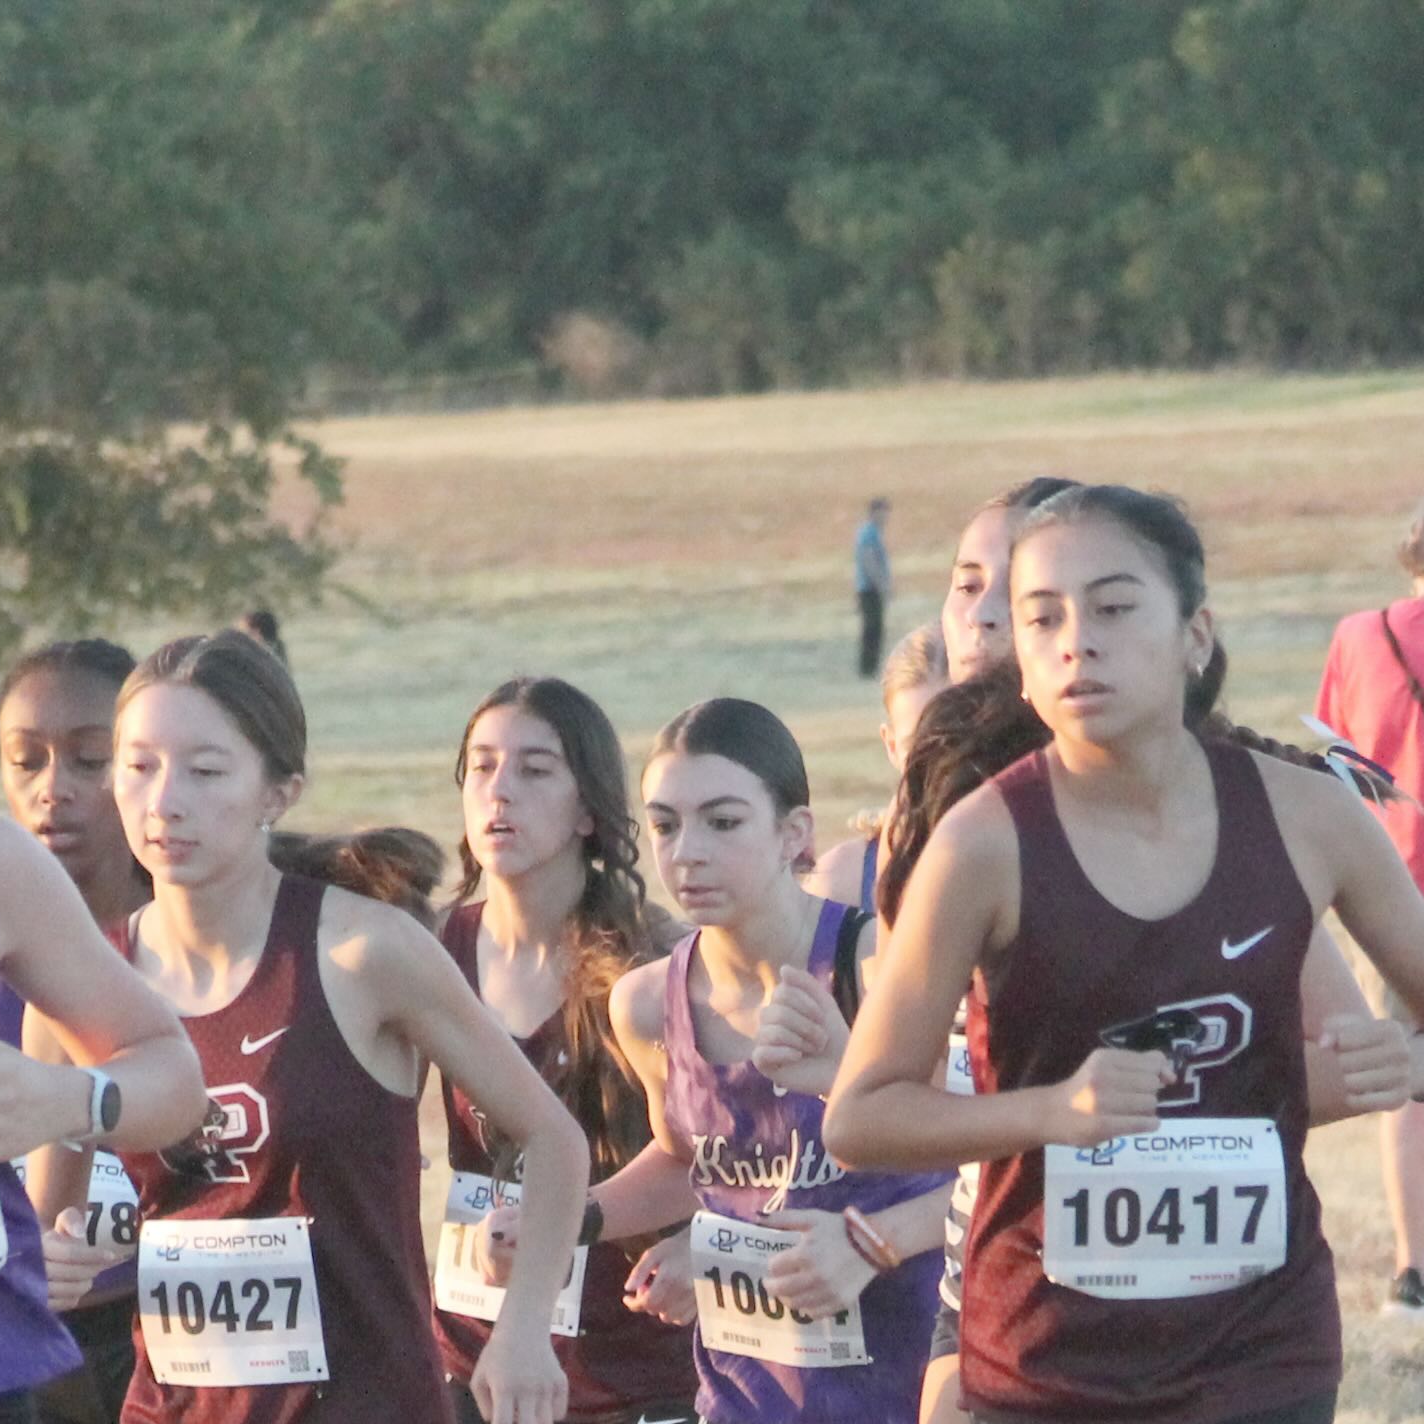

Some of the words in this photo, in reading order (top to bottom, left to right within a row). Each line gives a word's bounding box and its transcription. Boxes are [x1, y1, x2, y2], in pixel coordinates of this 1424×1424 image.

[1133, 1136, 1254, 1152] COMPTON
[193, 1233, 287, 1249] COMPTON
[1063, 1185, 1269, 1248] 10417
[150, 1277, 303, 1335] 10427
[703, 1266, 850, 1326] 100
